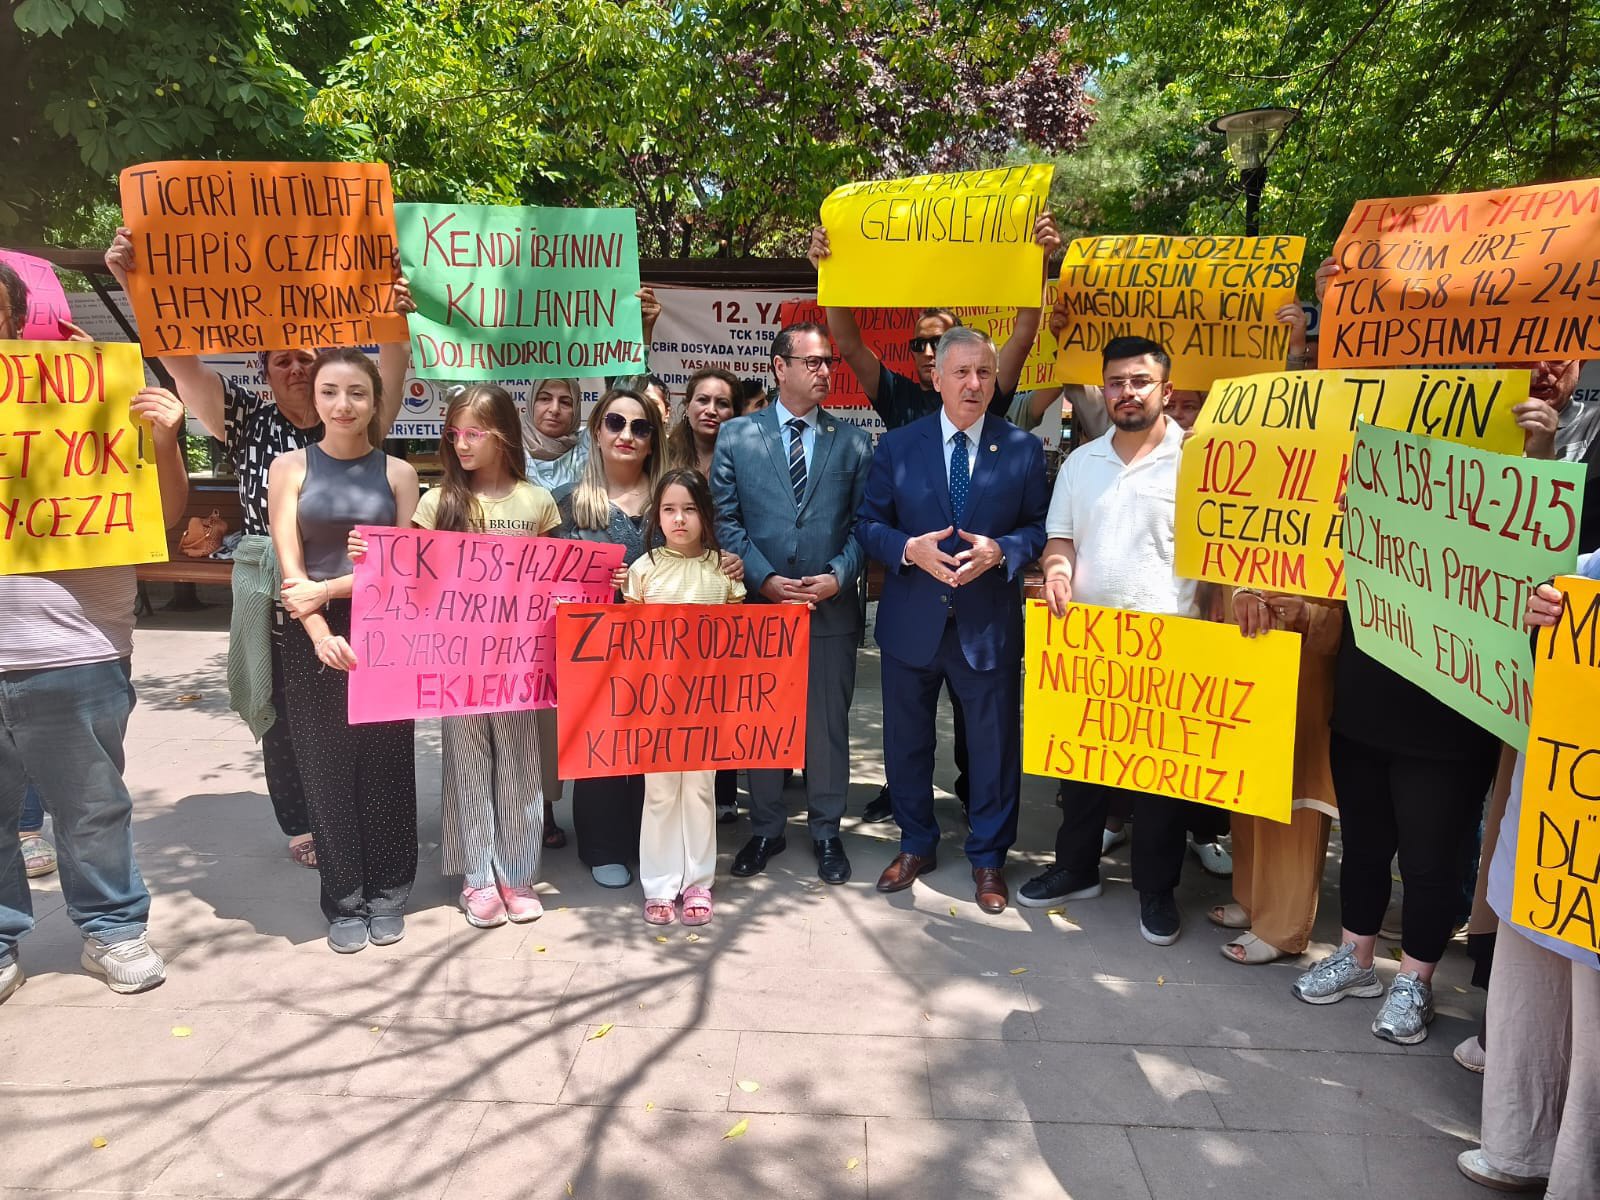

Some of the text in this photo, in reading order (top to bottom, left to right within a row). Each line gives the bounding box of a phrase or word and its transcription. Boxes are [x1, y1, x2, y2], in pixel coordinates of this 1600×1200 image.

[130, 170, 385, 217] TİCARİ İHTİLAFA
[423, 212, 520, 267] KENDİ
[1352, 203, 1468, 234] AYRIM
[146, 232, 395, 275] HAPİS CEZASINA
[1340, 225, 1571, 275] ÇÖZÜM ÜRET
[1067, 263, 1196, 288] TUTULSUN
[1333, 277, 1392, 316] TCK
[280, 283, 396, 319] AYRIMSIZ
[446, 282, 616, 328] KULLANAN
[1064, 288, 1204, 320] MAĞDURLAR
[1219, 289, 1265, 322] İÇİN
[283, 319, 373, 347] PAKETİ
[417, 334, 642, 369] DOLANDIRICI OLAMAZ
[681, 343, 734, 355] DOSYADA
[729, 329, 753, 341] TCK
[1182, 322, 1291, 361] ATILSIN
[1332, 317, 1502, 359] KAPSAMA
[734, 362, 750, 372] BU
[1210, 380, 1258, 427] 100
[1261, 374, 1324, 430] BİN
[1405, 374, 1502, 439] İÇİN
[1197, 437, 1257, 497] 102
[1277, 445, 1319, 502] YIL
[490, 519, 537, 532] BRIGHT
[1197, 499, 1310, 547] CEZASI
[368, 533, 438, 580] TCK
[1201, 542, 1306, 589] AYRIM
[435, 590, 518, 623] AYRIM
[1356, 578, 1423, 658] DAHİL
[401, 632, 468, 667] YARGI
[568, 612, 801, 662] ZARAR ÖDENEN
[1034, 601, 1165, 661] TCK 158
[610, 672, 777, 717] DOSYALAR
[1038, 650, 1256, 724] MAĞDURUYUZ
[586, 715, 797, 768] KAPATILSIN!
[1078, 698, 1237, 760] ADALET
[1044, 734, 1246, 805] İSTİYORUZ!
